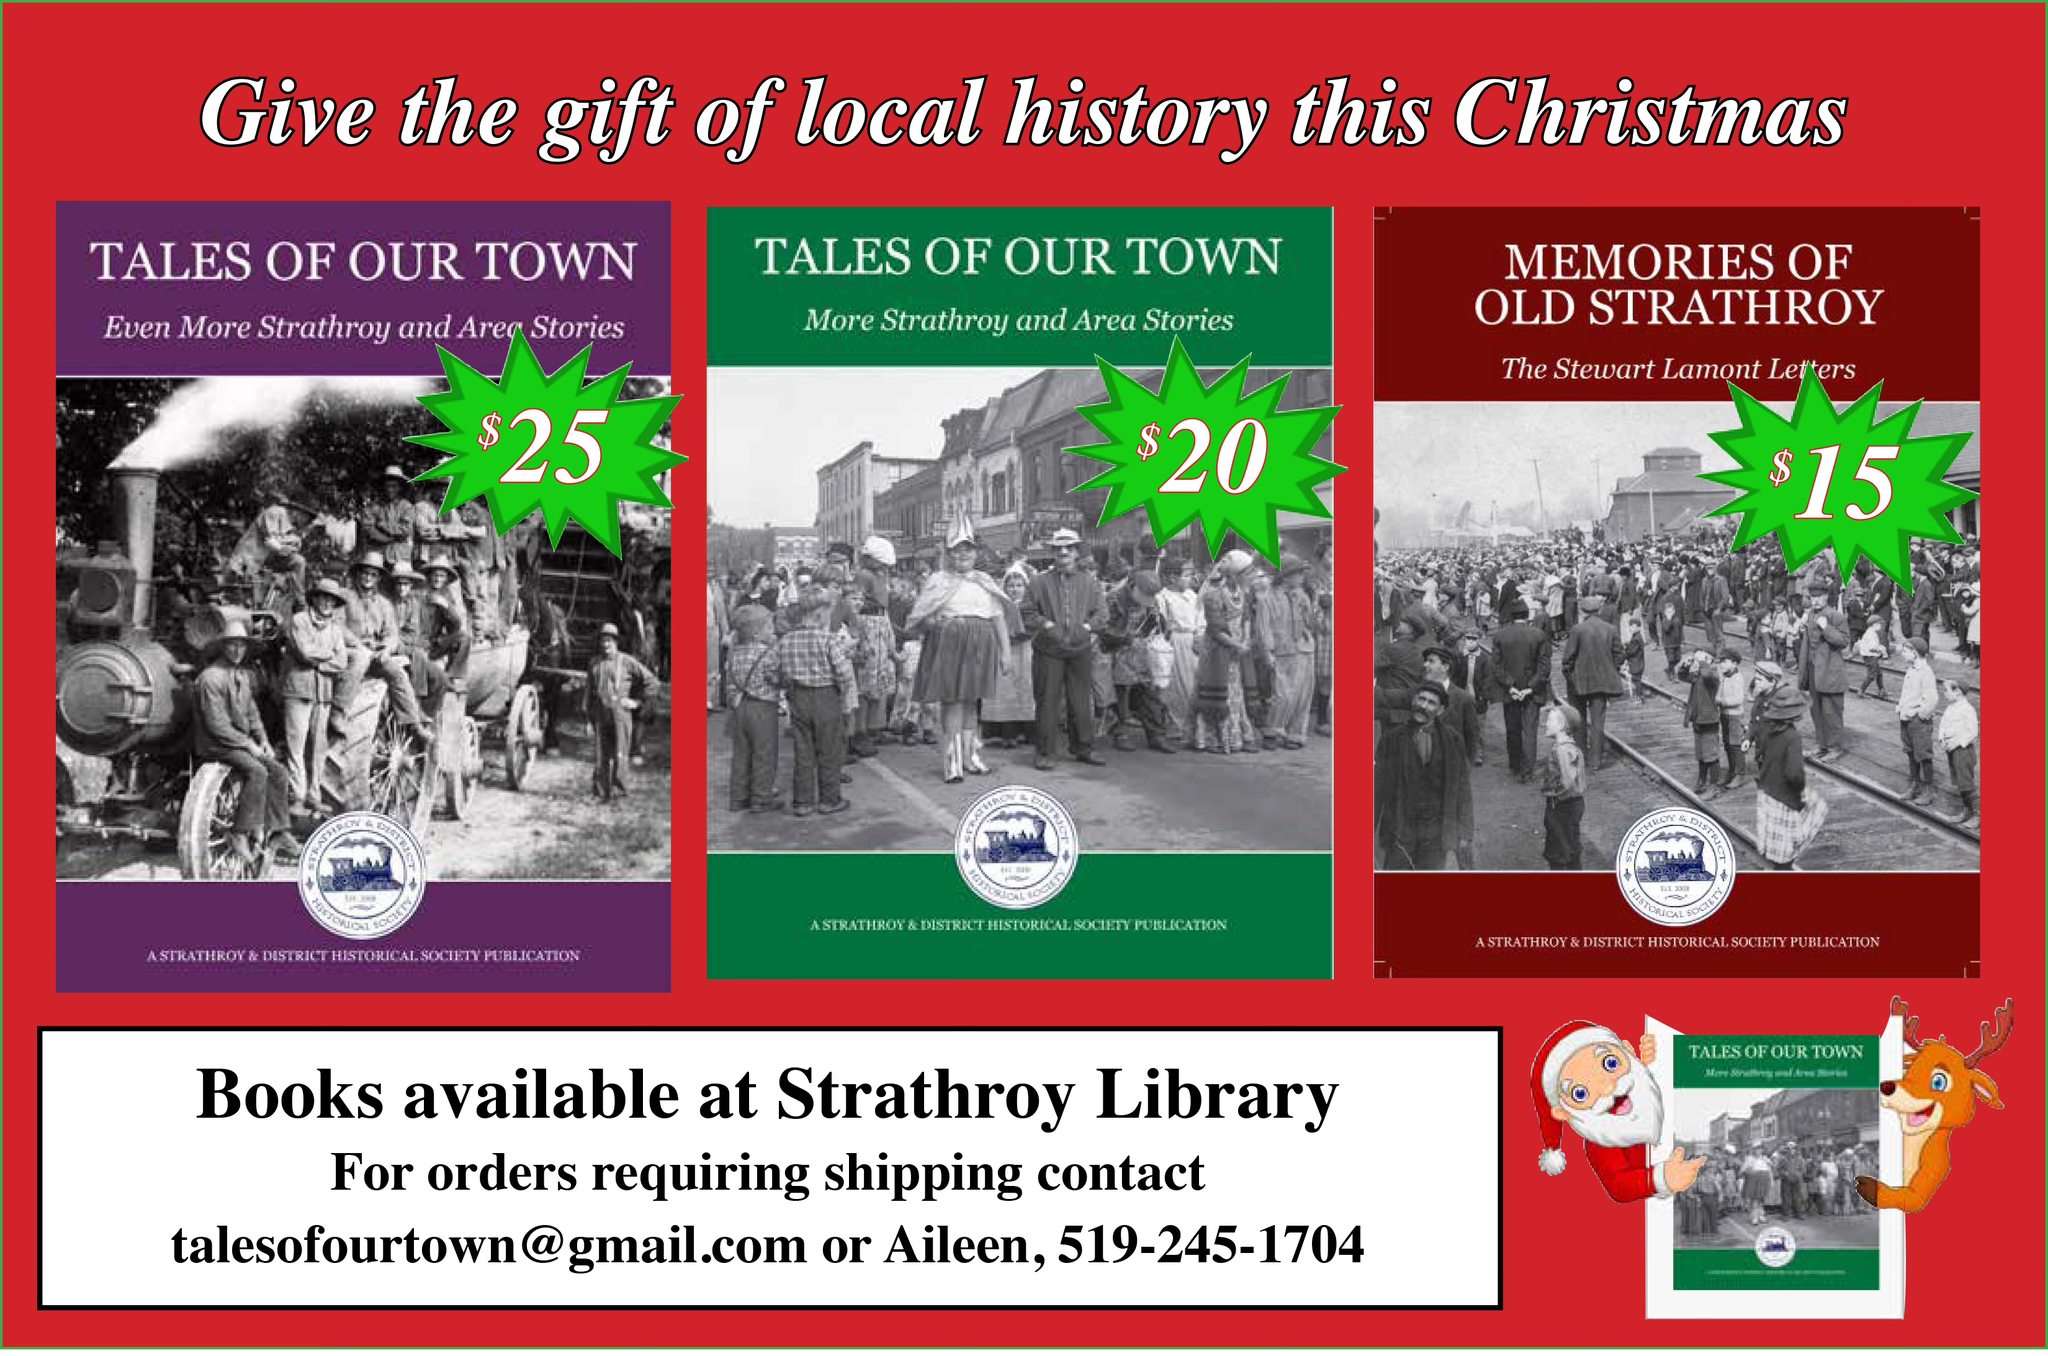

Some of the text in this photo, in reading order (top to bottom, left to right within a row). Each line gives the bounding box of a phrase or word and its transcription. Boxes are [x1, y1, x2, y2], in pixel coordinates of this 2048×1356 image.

[201, 74, 1849, 165] Give the gift of local history this Christmas
[89, 241, 638, 281] TALES OF OUR TOWN
[754, 237, 1283, 275] TALES OF OUR TOWN
[1505, 243, 1852, 280] MEMORIES OF
[804, 308, 1234, 336] More Strathroy and Area Stories
[1475, 289, 1884, 325] OLD STRATHROY
[104, 316, 170, 339] Even
[178, 316, 251, 339] More
[257, 314, 391, 344] Strathroy
[399, 314, 452, 339] and
[531, 314, 625, 339] Stories
[1502, 357, 1547, 380] The
[1554, 358, 1656, 380] Stewart
[1662, 358, 1762, 380] Lamont
[477, 407, 609, 485] $25
[1136, 417, 1269, 495] $20
[1768, 443, 1900, 521] $15
[1625, 814, 1727, 864] STRATHROY & DISTRICT
[1629, 886, 1725, 919] HISTORICAL SOCIETY
[811, 919, 1227, 931] A STRATHROY & DISTRICT HISTORICAL SOCIETY PUBLICATION
[1476, 936, 1881, 948] A STRATHROY & DISTRICT HISTORICAL SOCIETY PUBLICATION
[147, 950, 580, 962] A STRATHROY & DISTRICT HISTORICAL SOCIETY PUBLICATION
[1689, 1045, 1863, 1059] TALES OF OUR TOWN
[196, 1067, 1340, 1131] Books available at Strathroy Library
[331, 1152, 1206, 1201] For orders requiring shipping contact
[171, 1225, 1365, 1275] talesofourtown@gmail.com or Aileen, 519-245-1704
